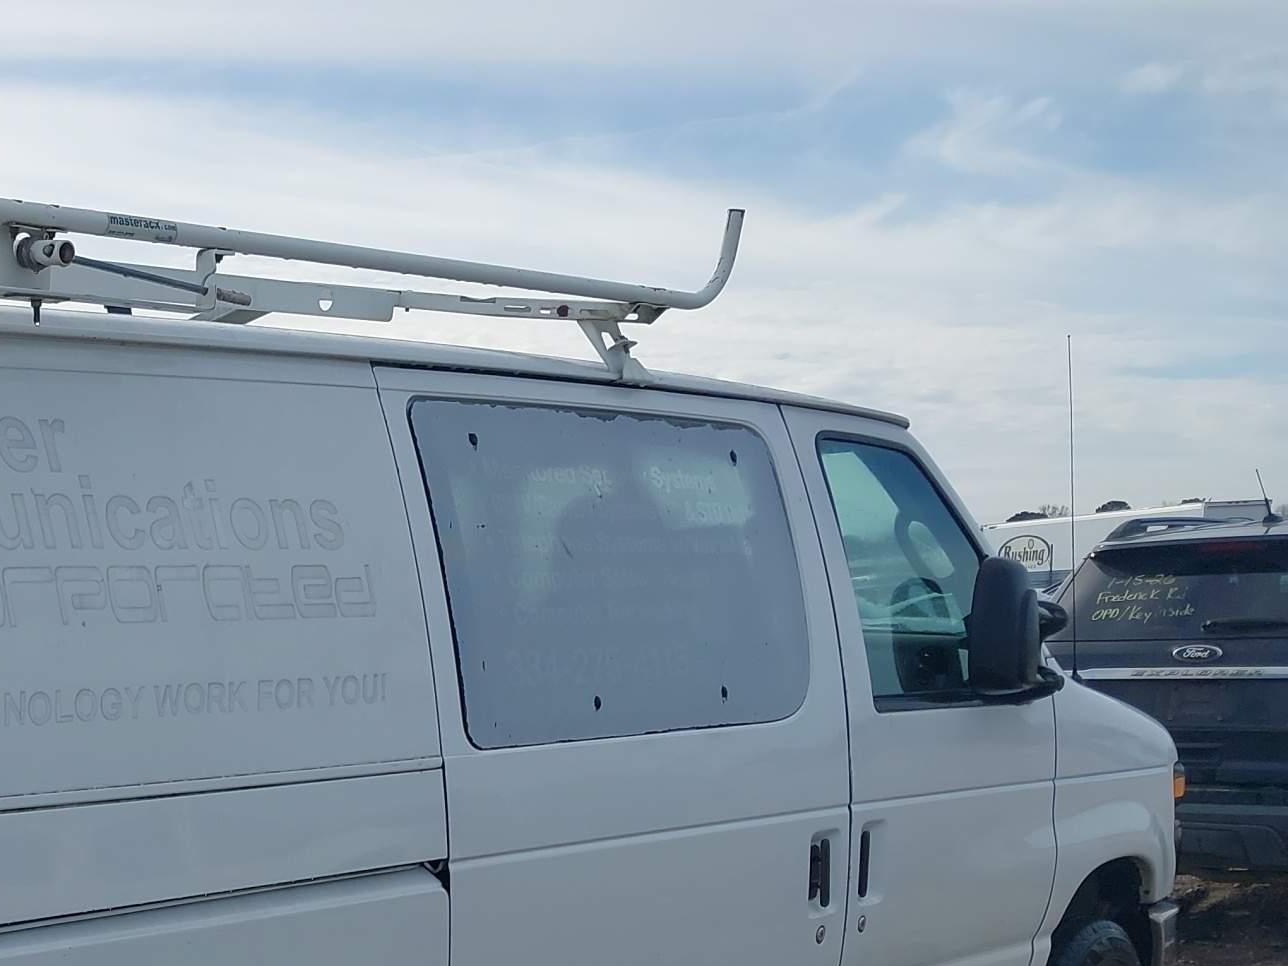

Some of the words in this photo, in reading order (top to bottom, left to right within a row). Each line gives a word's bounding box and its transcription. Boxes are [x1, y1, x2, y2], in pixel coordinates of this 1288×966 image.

[1003, 546, 1046, 566] Rushing
[153, 681, 249, 718] WORK
[256, 678, 314, 712] FOR
